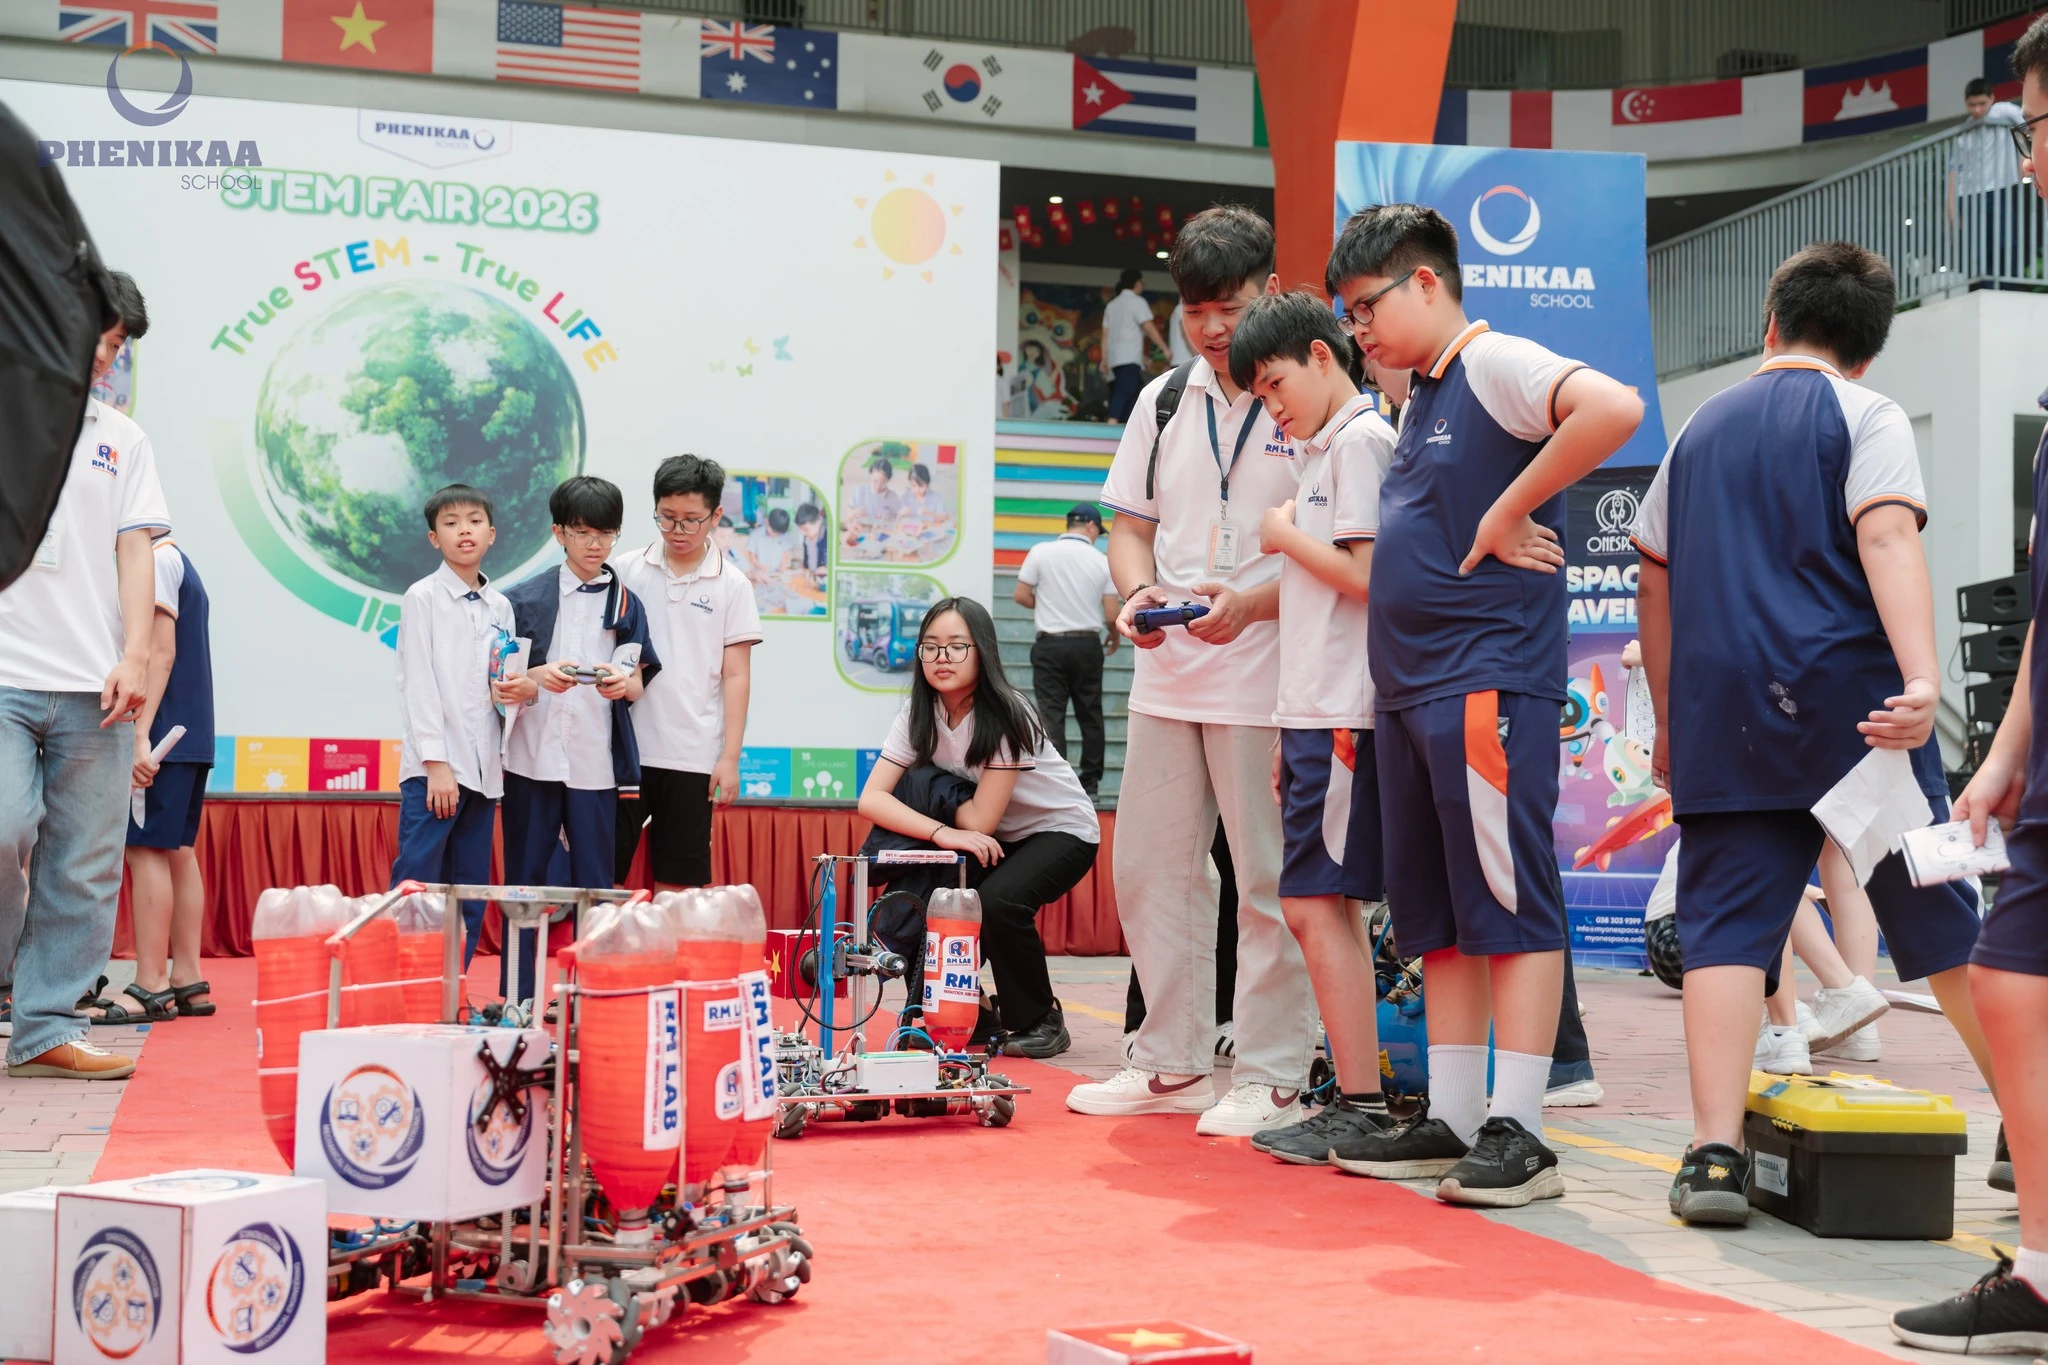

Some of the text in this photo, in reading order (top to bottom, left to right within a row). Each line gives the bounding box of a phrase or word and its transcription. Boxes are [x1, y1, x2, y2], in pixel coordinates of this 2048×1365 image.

[375, 121, 471, 140] PHENIKAA
[221, 167, 600, 234] STEM FAIR 2026
[1461, 264, 1596, 290] ENIKAA
[210, 285, 294, 355] True
[294, 236, 411, 292] STEM
[455, 241, 541, 302] True
[542, 291, 618, 373] LIFE
[1530, 293, 1595, 309] SCHOOL
[1265, 444, 1279, 453] RM
[1280, 445, 1295, 456] LB
[92, 459, 105, 469] RM
[1586, 536, 1635, 553] ONESPA
[1566, 564, 1640, 593] SPAC
[1567, 598, 1638, 625] AVEL
[802, 752, 811, 760] 15
[866, 752, 876, 760] 16
[1595, 916, 1609, 925] 038
[1610, 916, 1624, 925] 303
[1576, 925, 1645, 934] info@myonespace.o
[945, 972, 972, 990] RM
[708, 1004, 731, 1020] RM
[751, 981, 775, 1100] RM LAB
[663, 1064, 678, 1131] LAB
